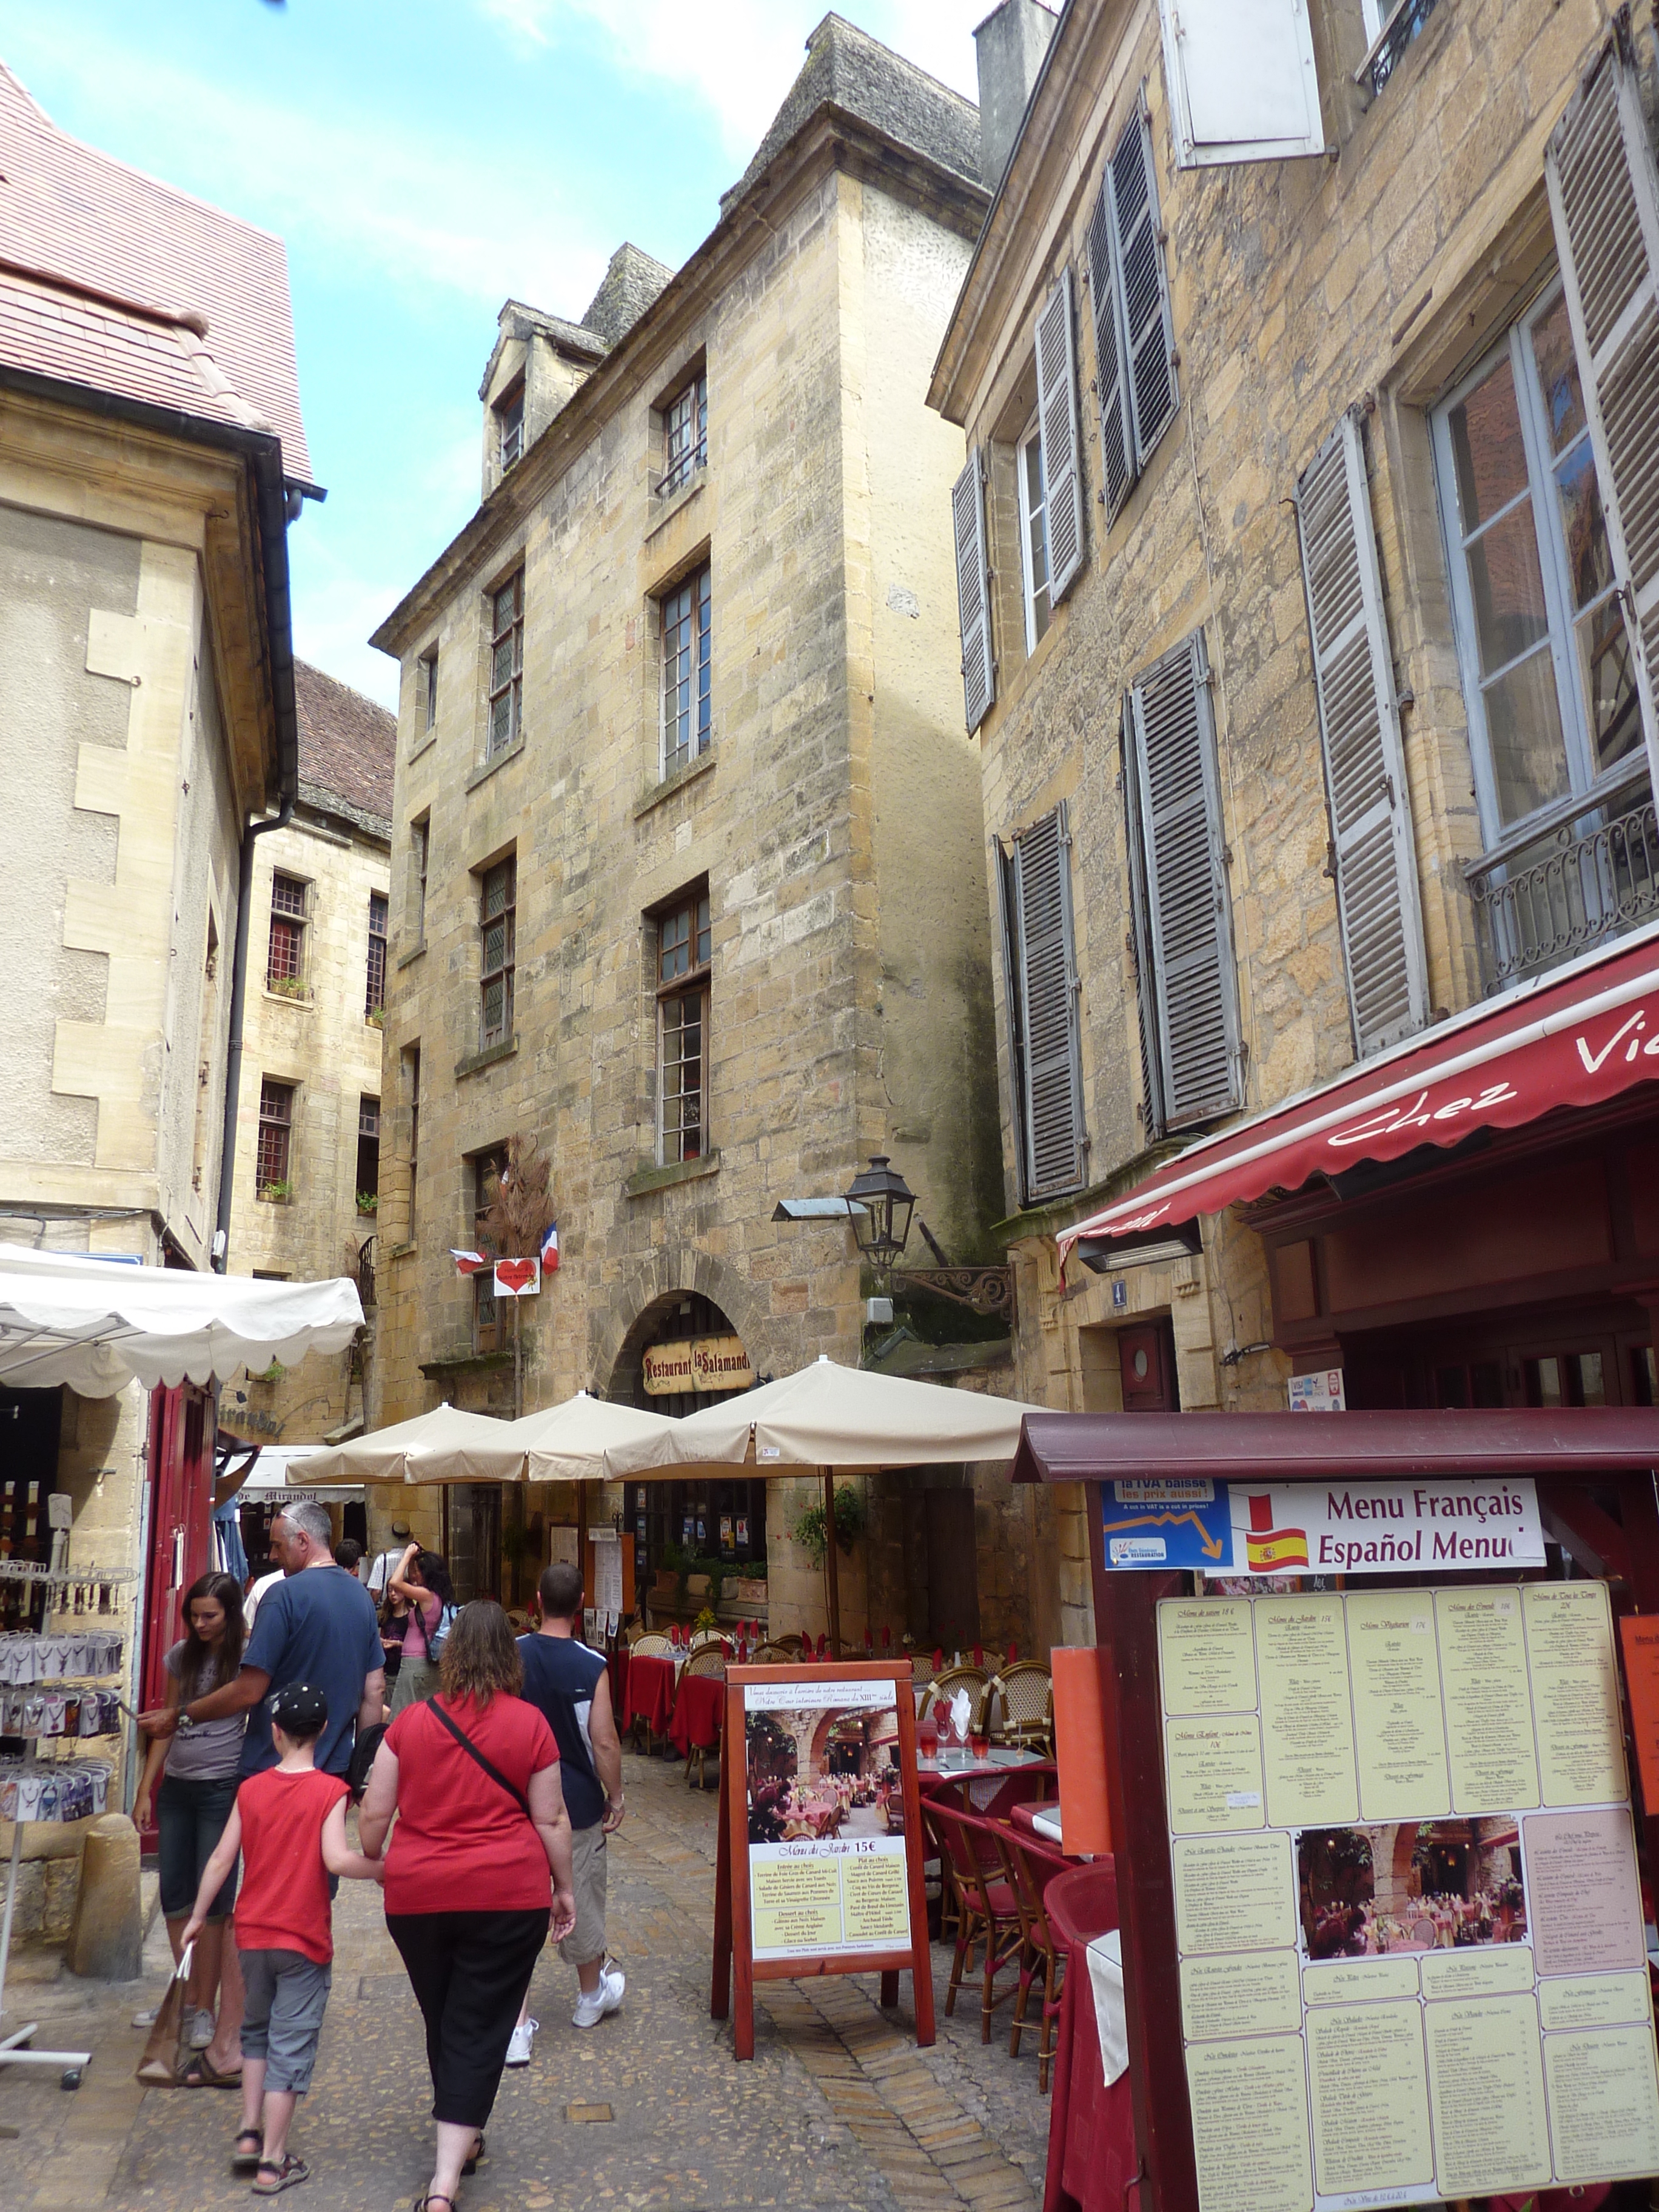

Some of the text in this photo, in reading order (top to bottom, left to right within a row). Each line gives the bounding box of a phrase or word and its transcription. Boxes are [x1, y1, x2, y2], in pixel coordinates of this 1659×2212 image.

[1328, 1082, 1517, 1146] Chez
[1116, 1285, 1121, 1302] 4
[646, 1356, 691, 1384] Restaurant
[694, 1349, 702, 1367] la
[1165, 1478, 1207, 1487] baisse
[264, 1492, 317, 1501] Mirandol
[1122, 1489, 1139, 1498] les
[1144, 1489, 1165, 1500] prix
[1170, 1488, 1201, 1498] aussi
[1327, 1486, 1524, 1523] Menu Français
[1319, 1530, 1422, 1570] Español
[779, 1841, 876, 1857] Menu du Jardin 15€
